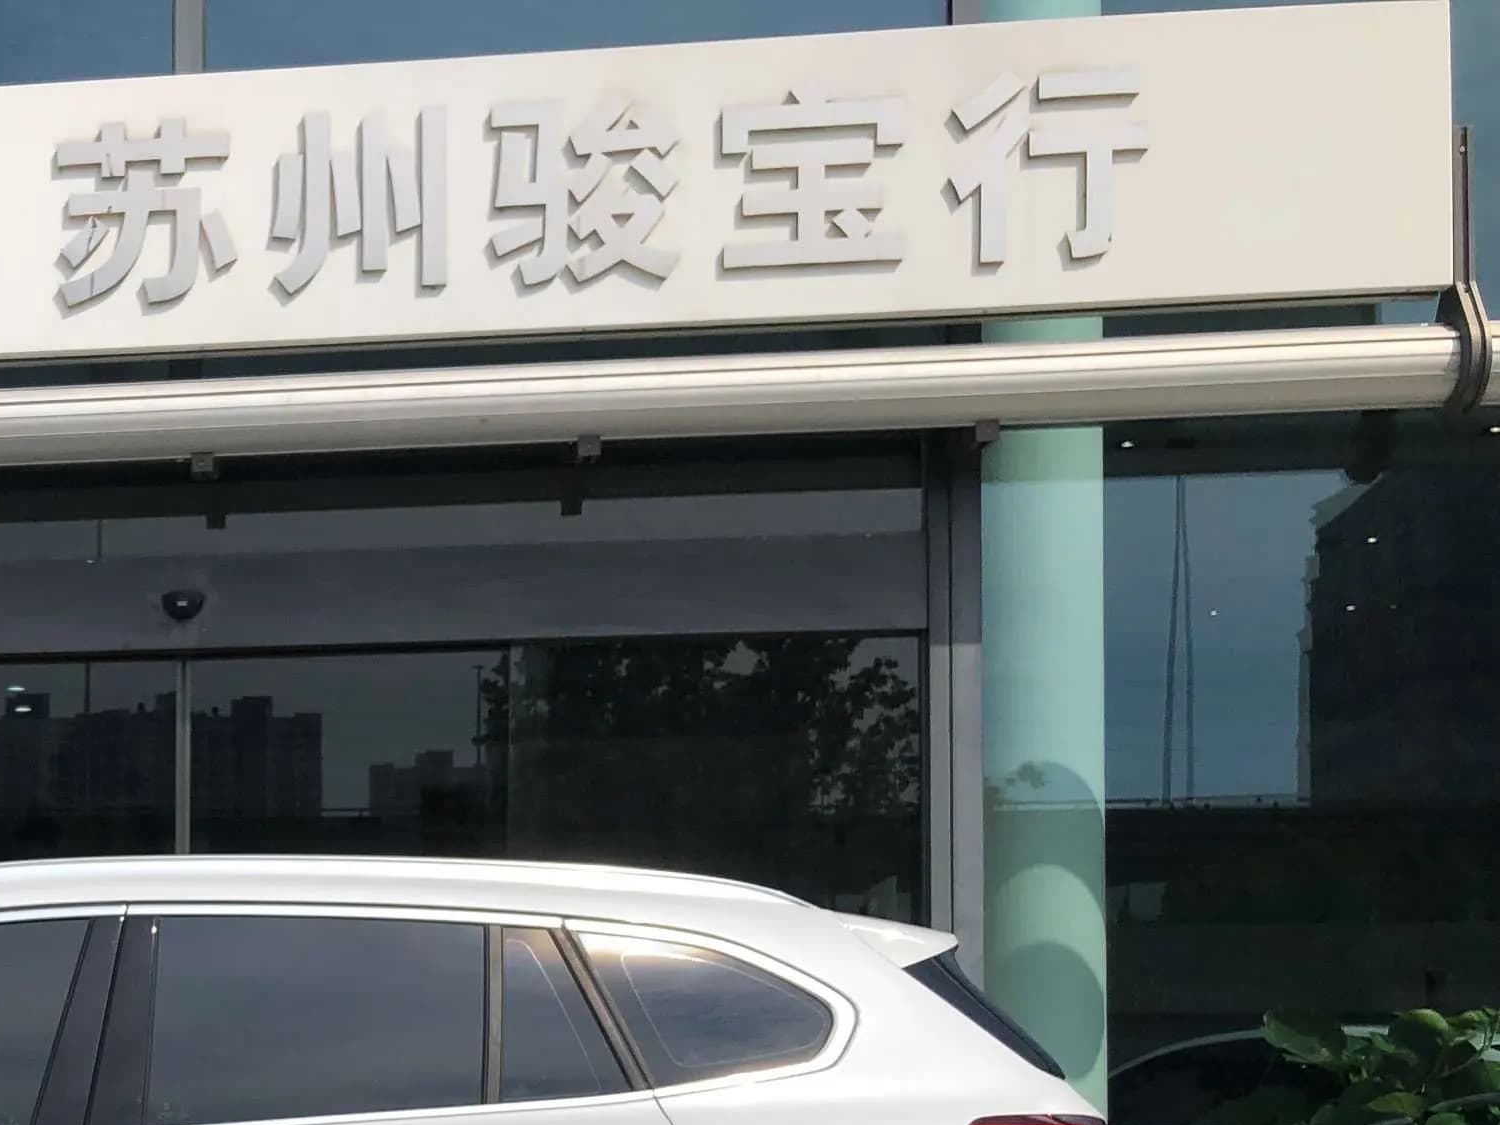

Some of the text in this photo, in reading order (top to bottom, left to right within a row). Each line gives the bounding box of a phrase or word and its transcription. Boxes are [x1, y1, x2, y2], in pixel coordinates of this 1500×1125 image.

[55, 64, 1148, 309] 苏州骏宝行
